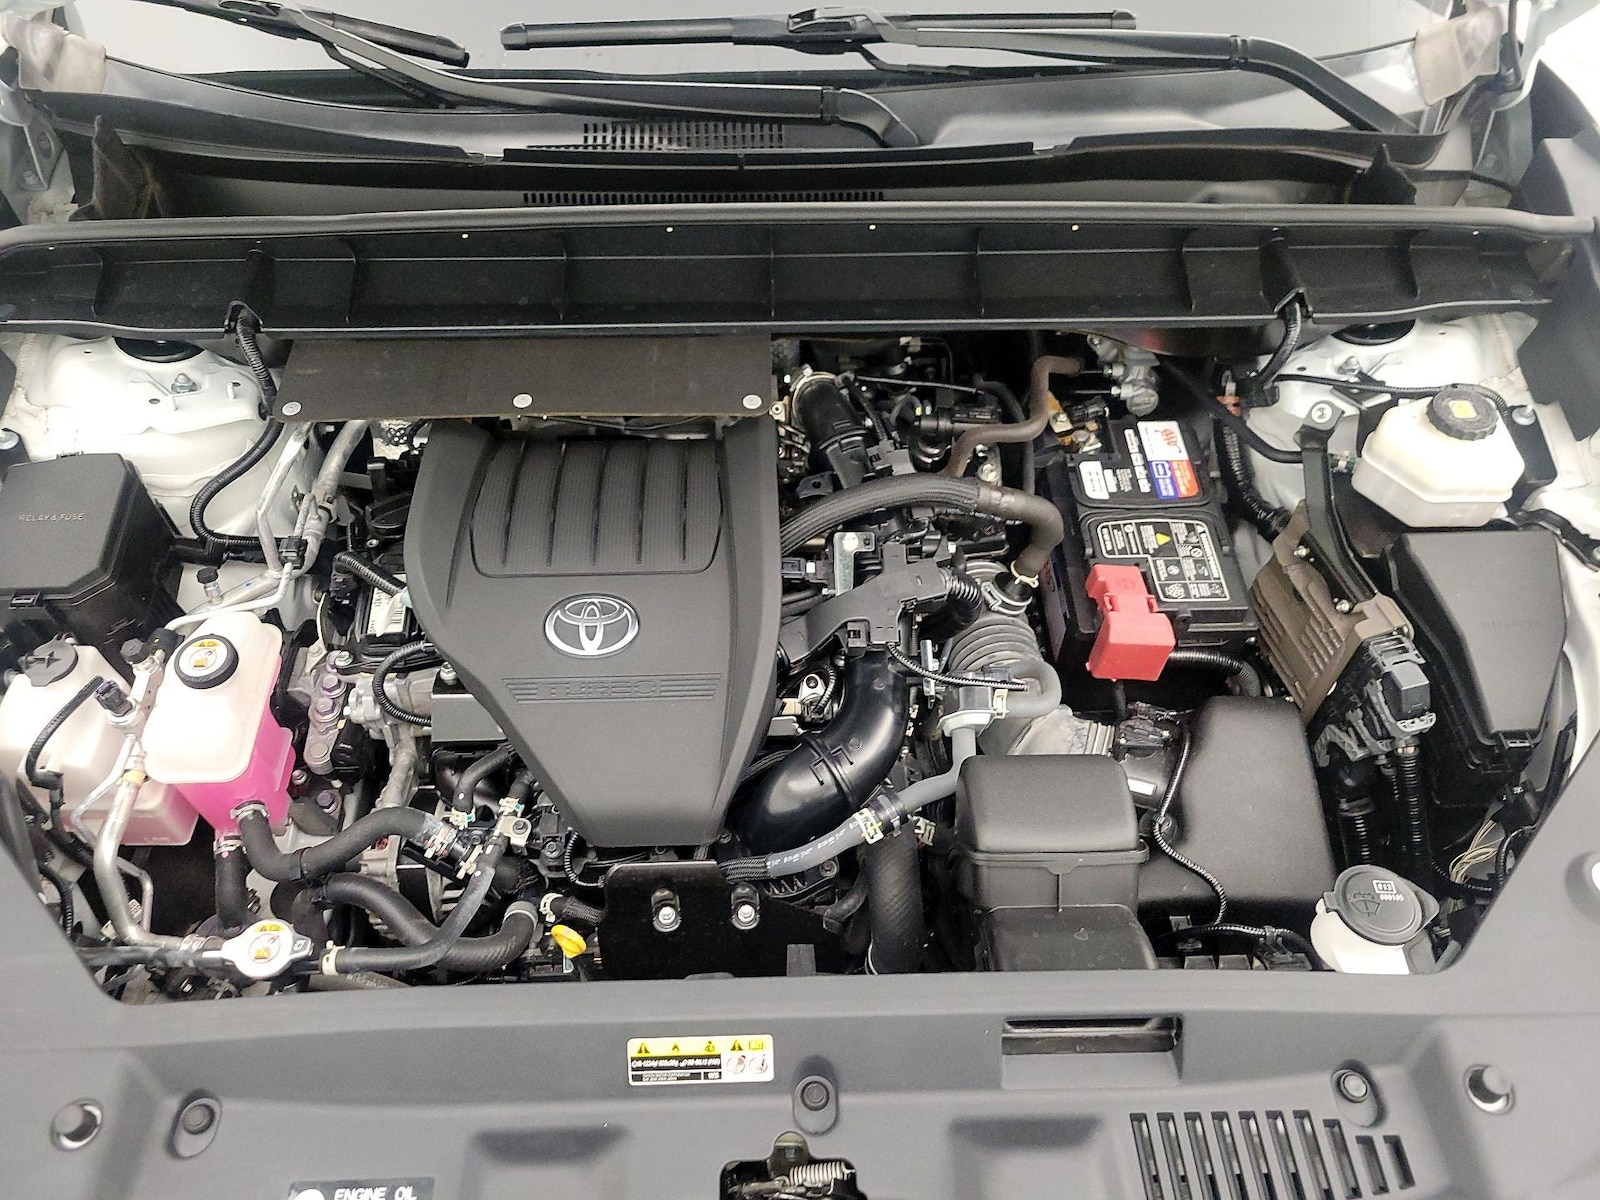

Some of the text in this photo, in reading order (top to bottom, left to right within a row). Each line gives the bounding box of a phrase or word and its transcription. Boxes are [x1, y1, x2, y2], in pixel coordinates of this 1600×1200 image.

[58, 512, 85, 521] FUSE
[541, 680, 657, 697] TURBO
[333, 1186, 417, 1200] ENGINE OIL
